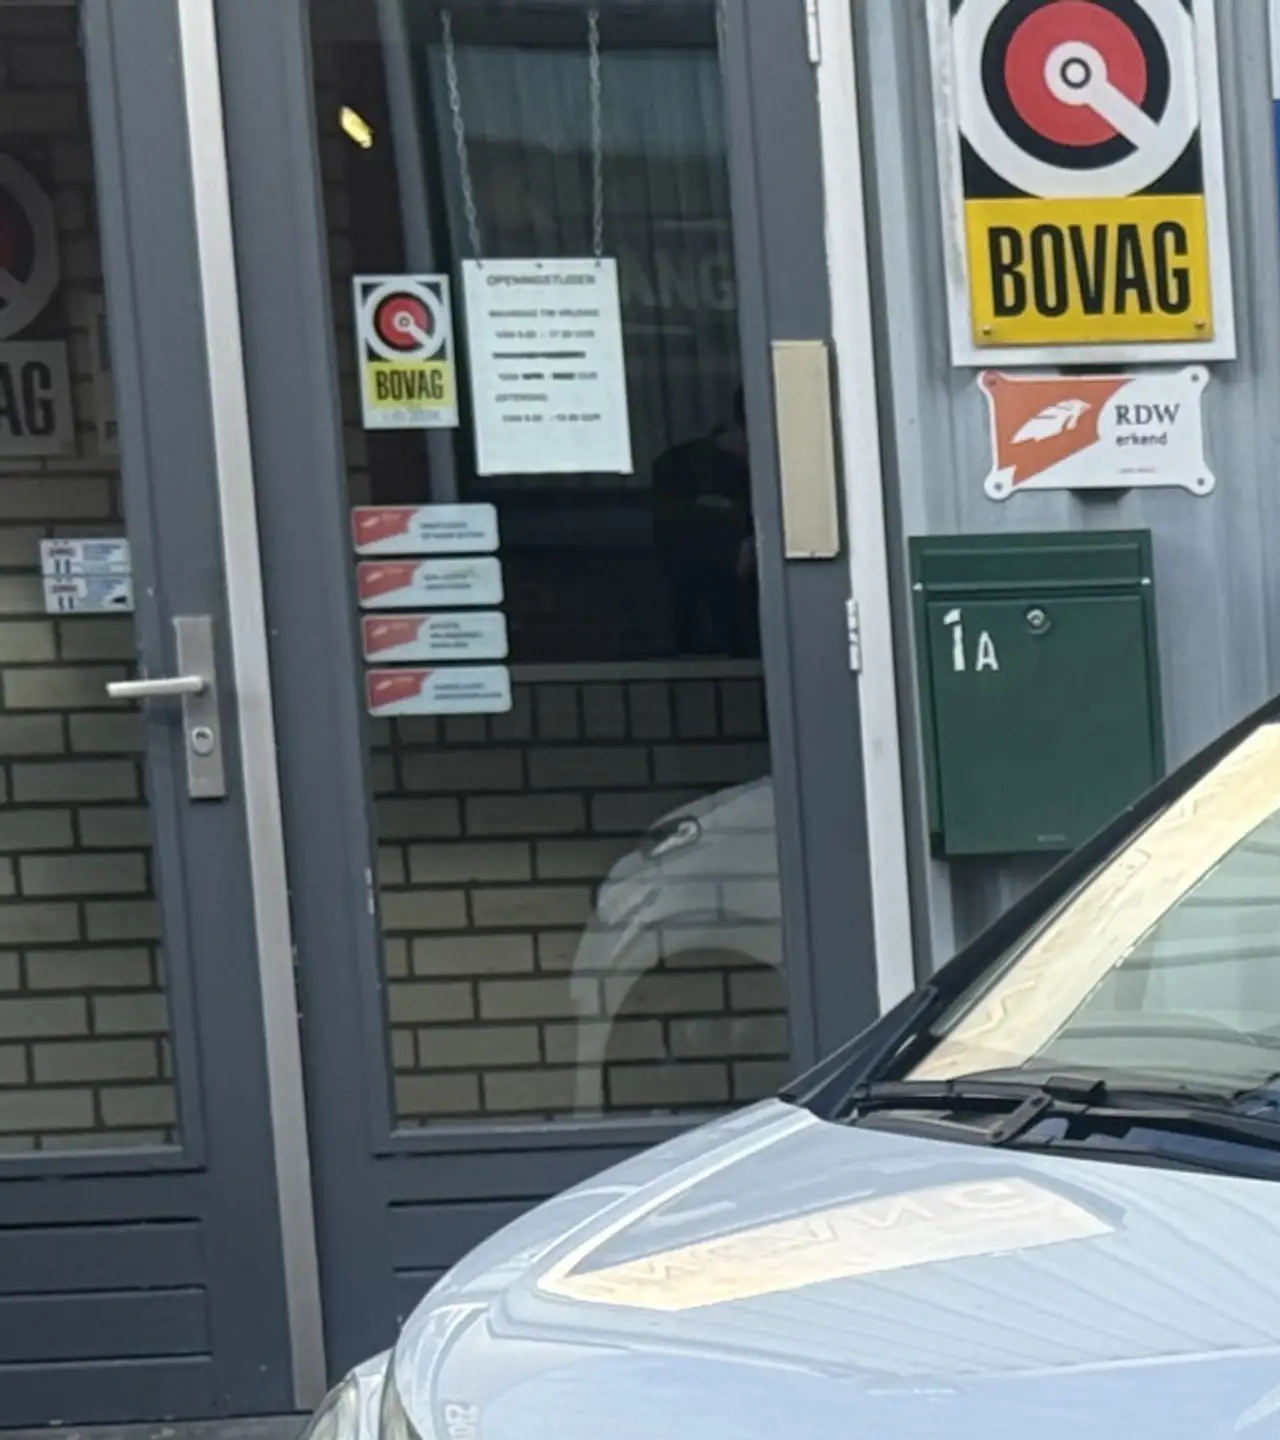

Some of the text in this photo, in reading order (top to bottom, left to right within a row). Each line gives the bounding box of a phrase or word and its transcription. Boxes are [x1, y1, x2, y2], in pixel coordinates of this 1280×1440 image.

[987, 220, 1191, 318] BOVAG
[375, 368, 444, 401] BOVAG
[1114, 403, 1181, 426] RDW
[1115, 431, 1168, 447] erkend
